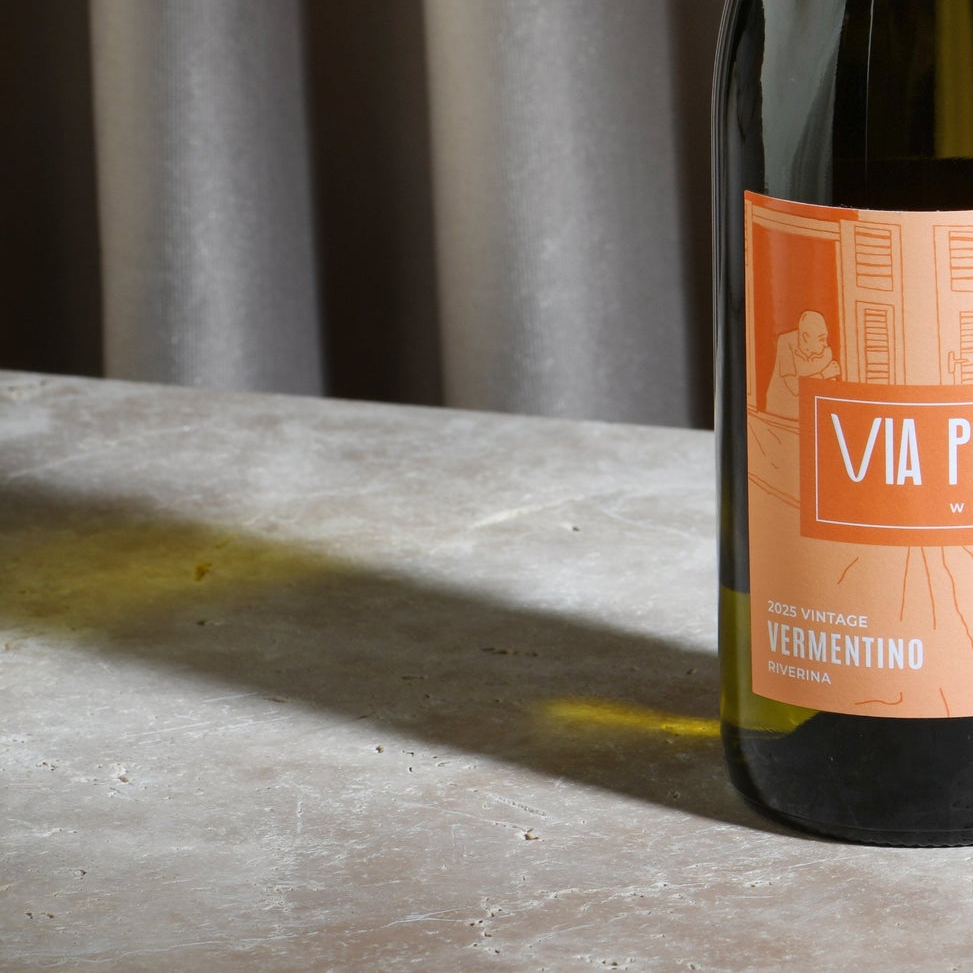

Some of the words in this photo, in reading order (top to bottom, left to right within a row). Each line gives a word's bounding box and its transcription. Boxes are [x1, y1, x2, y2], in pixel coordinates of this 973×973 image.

[831, 413, 922, 485] VIA
[767, 600, 797, 618] 2025
[801, 608, 869, 628] VINTAGE
[767, 620, 924, 670] VERMENTINO
[767, 660, 832, 685] RIVERINA
